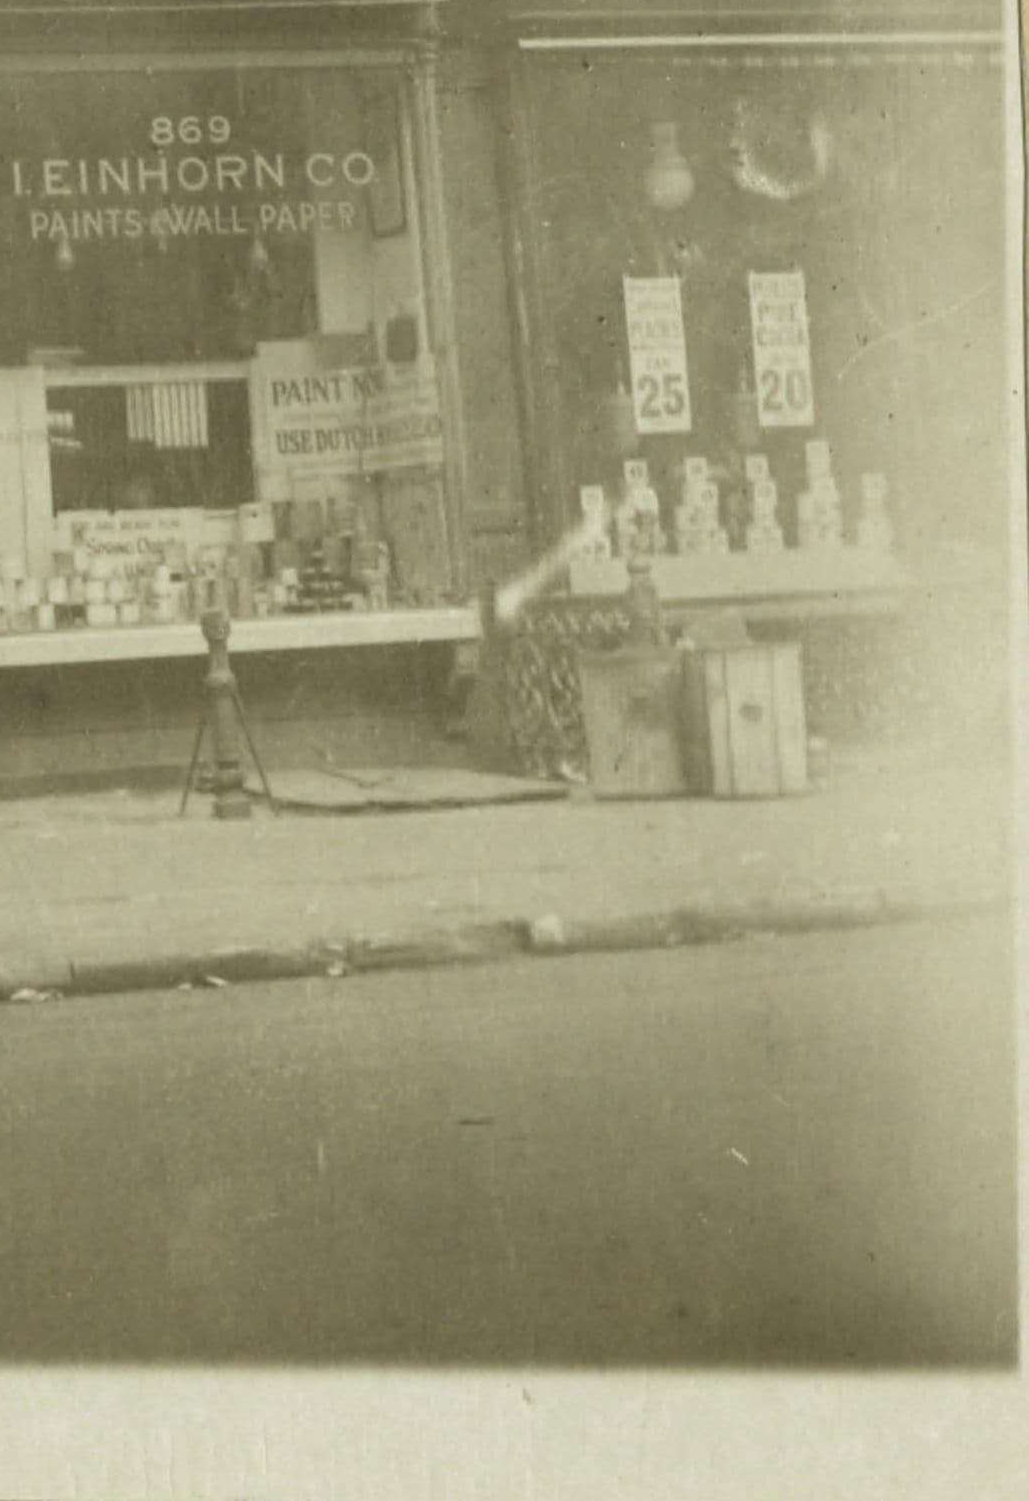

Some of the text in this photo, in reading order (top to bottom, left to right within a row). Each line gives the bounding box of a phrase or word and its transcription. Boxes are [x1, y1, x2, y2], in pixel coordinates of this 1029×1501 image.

[150, 115, 231, 145] 869
[29, 208, 144, 241] PAINTS
[169, 202, 249, 236] WALL
[258, 200, 357, 234] PAPER
[272, 376, 344, 407] PAINT
[637, 371, 685, 418] 25
[760, 368, 809, 412] 20
[276, 428, 313, 455] USE
